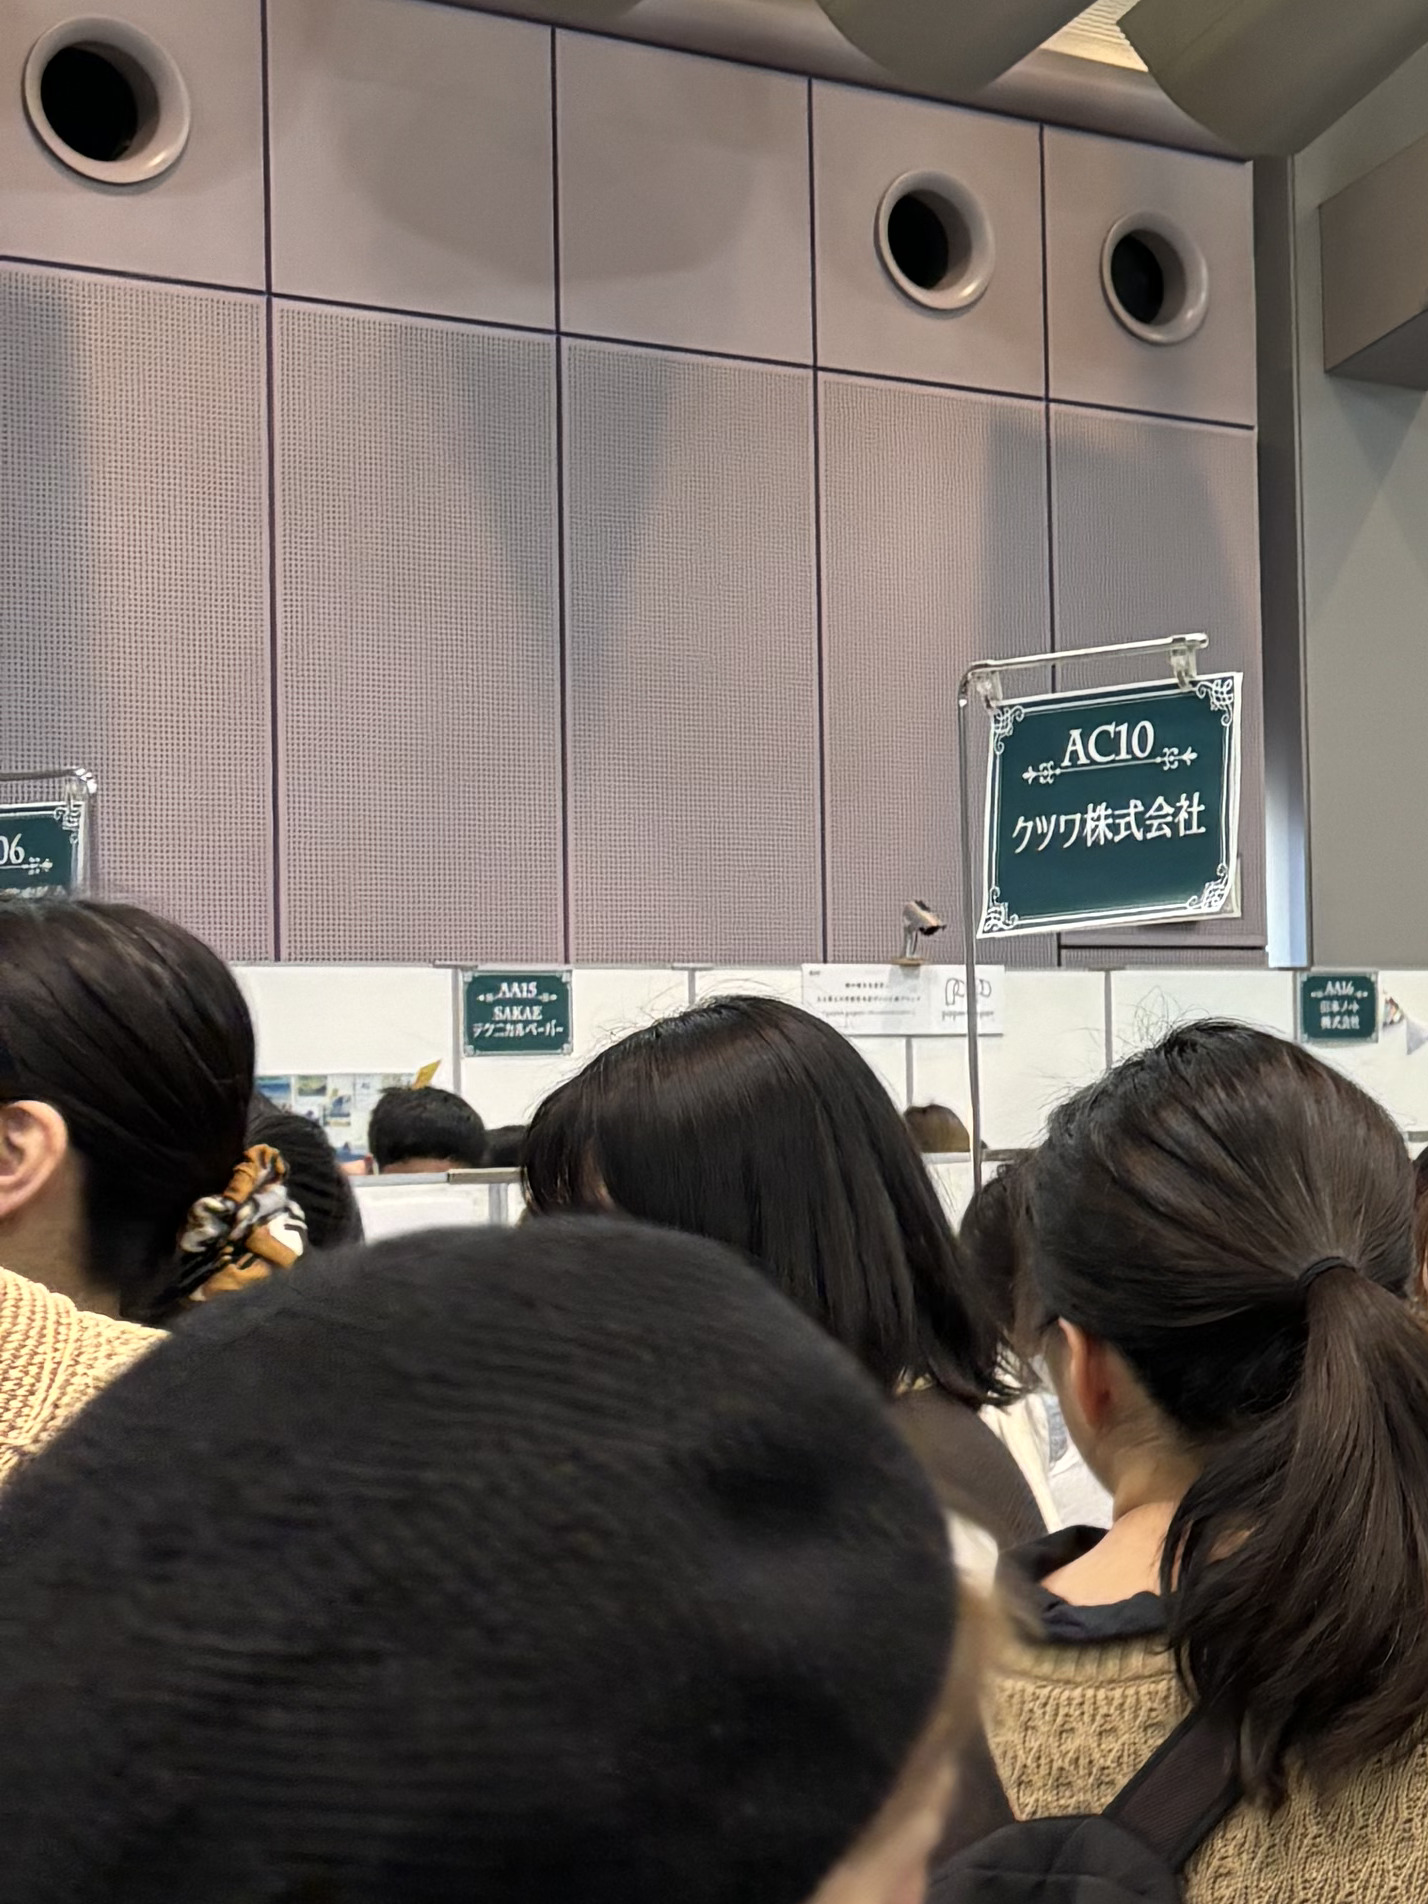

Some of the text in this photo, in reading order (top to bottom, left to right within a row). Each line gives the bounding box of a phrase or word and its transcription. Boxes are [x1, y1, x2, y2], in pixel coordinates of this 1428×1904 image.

[1060, 720, 1155, 768] AC10
[1012, 791, 1207, 854] クツワ株式会社
